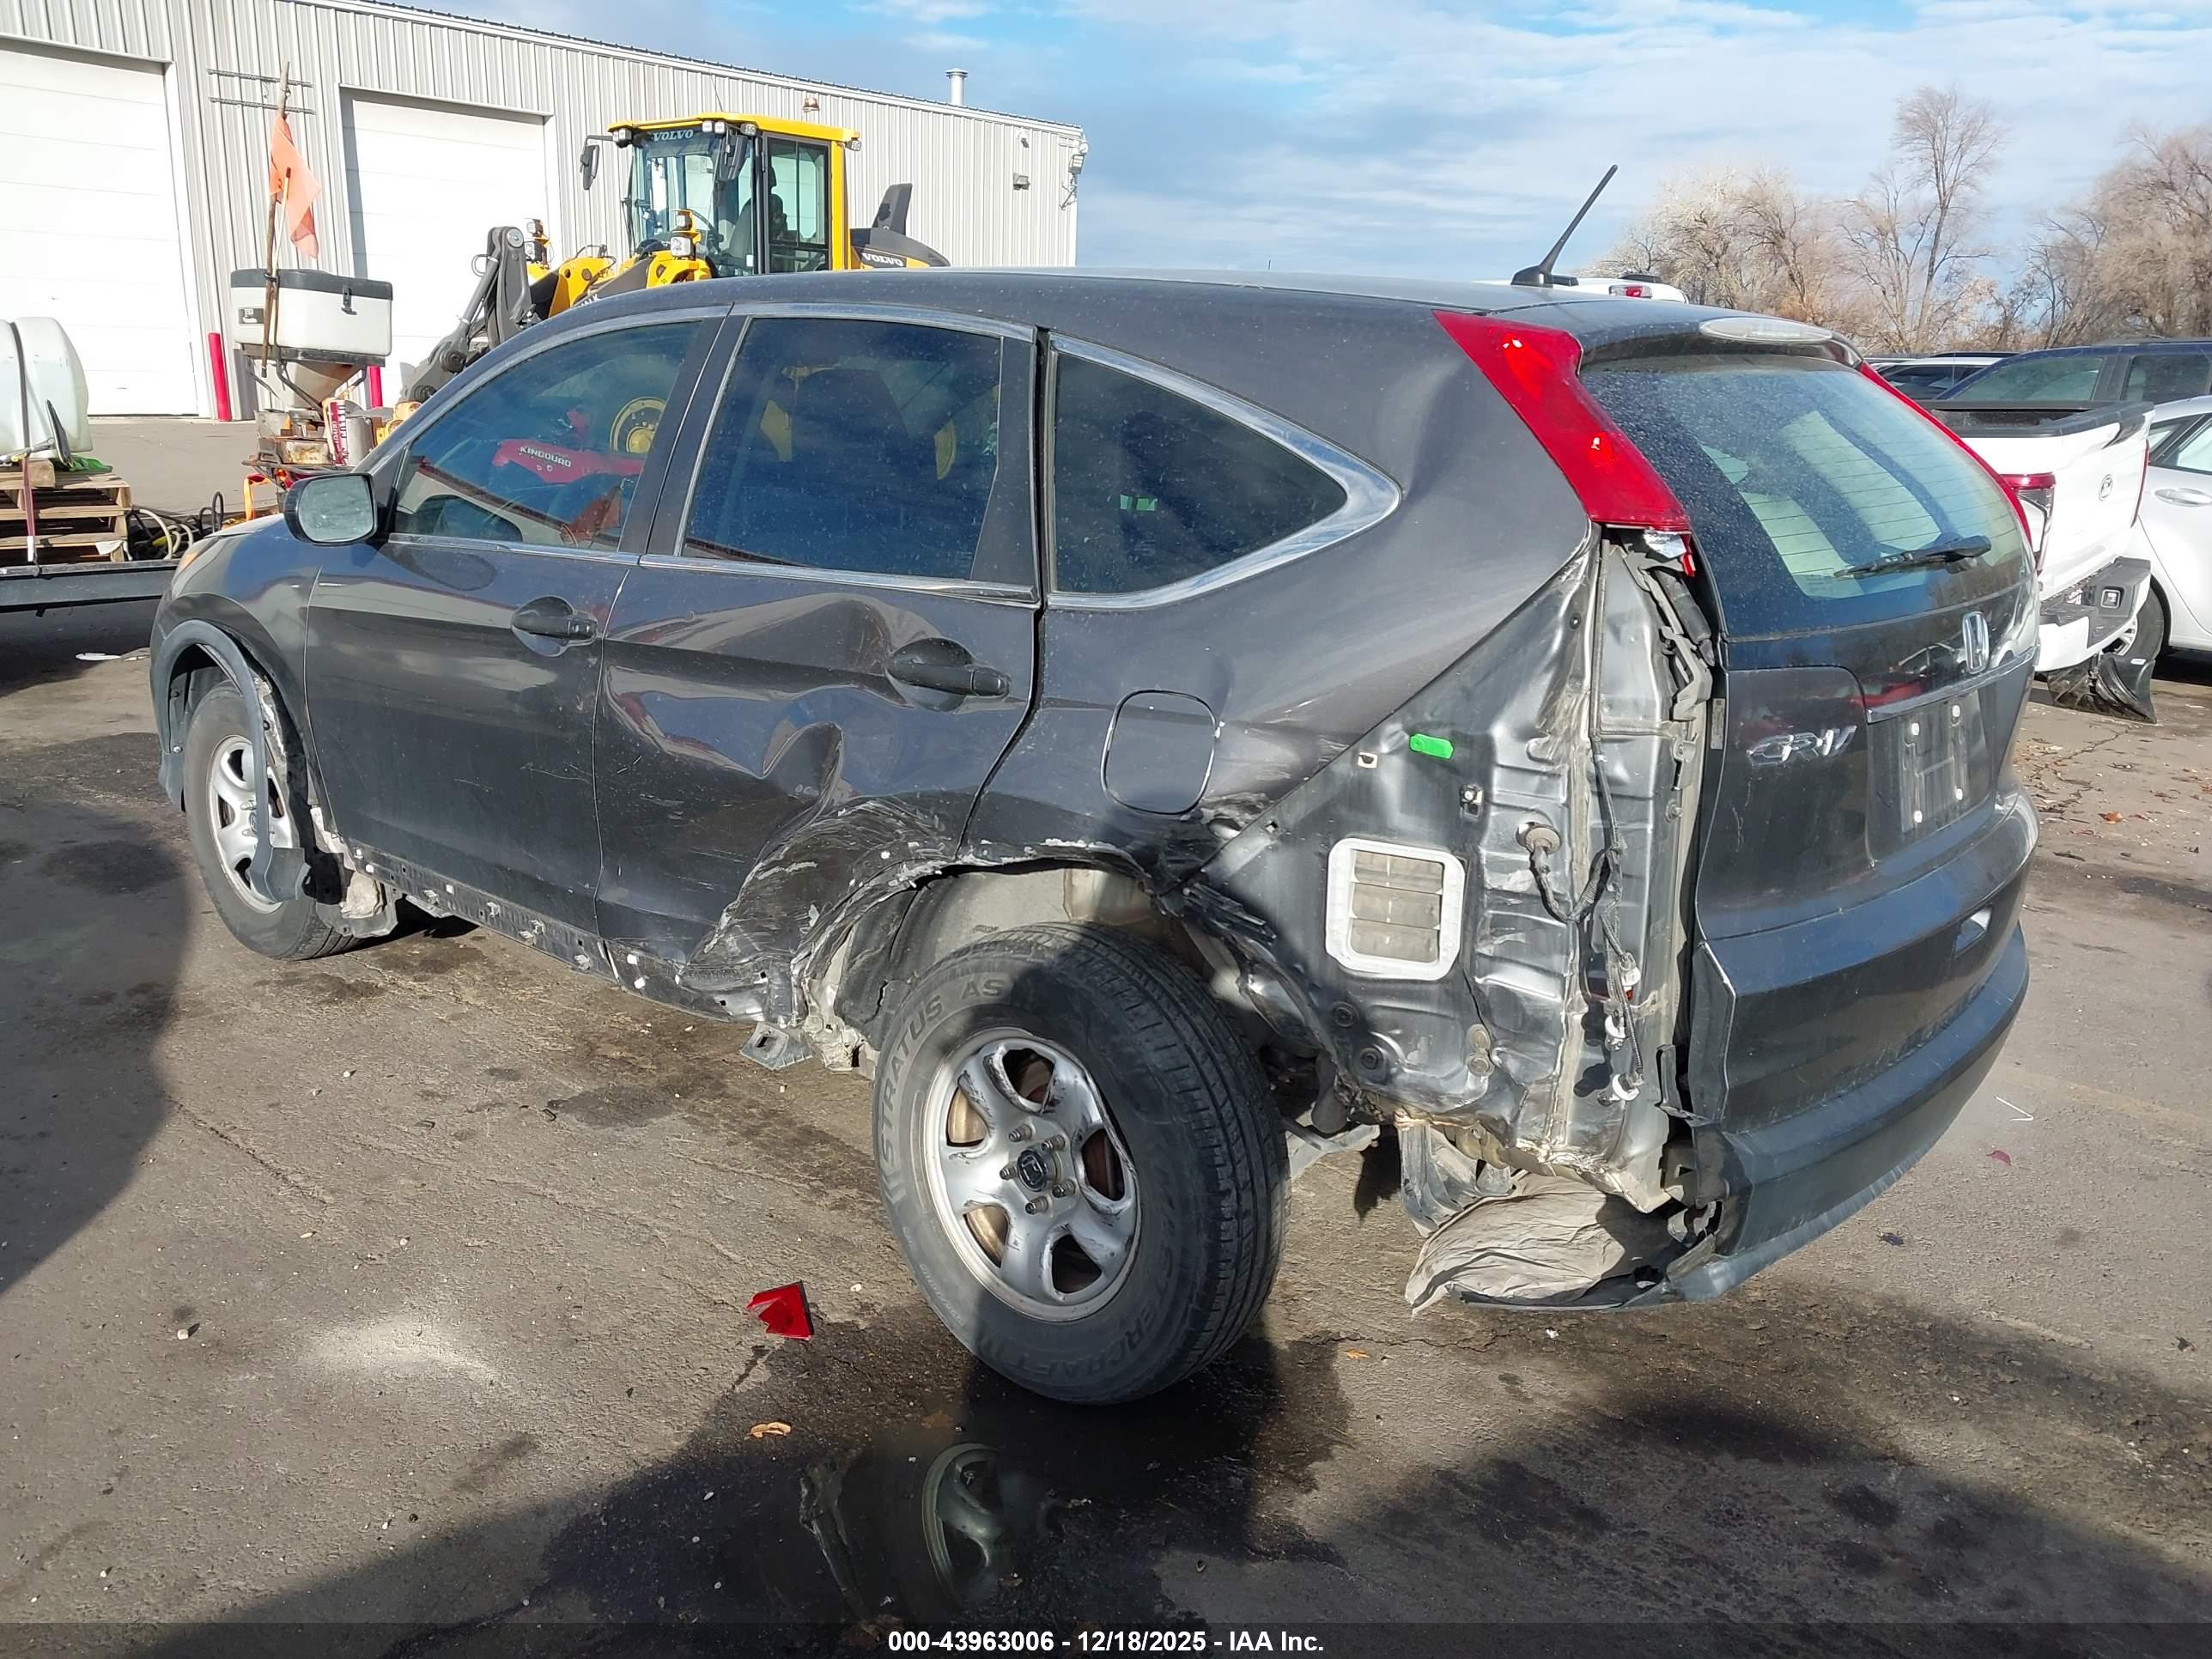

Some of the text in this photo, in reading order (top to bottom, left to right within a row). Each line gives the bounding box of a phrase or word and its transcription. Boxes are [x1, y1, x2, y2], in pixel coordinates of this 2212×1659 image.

[653, 129, 694, 142] VOLVO
[861, 252, 904, 267] VOLVO
[881, 979, 1006, 1168] STRATUS AS
